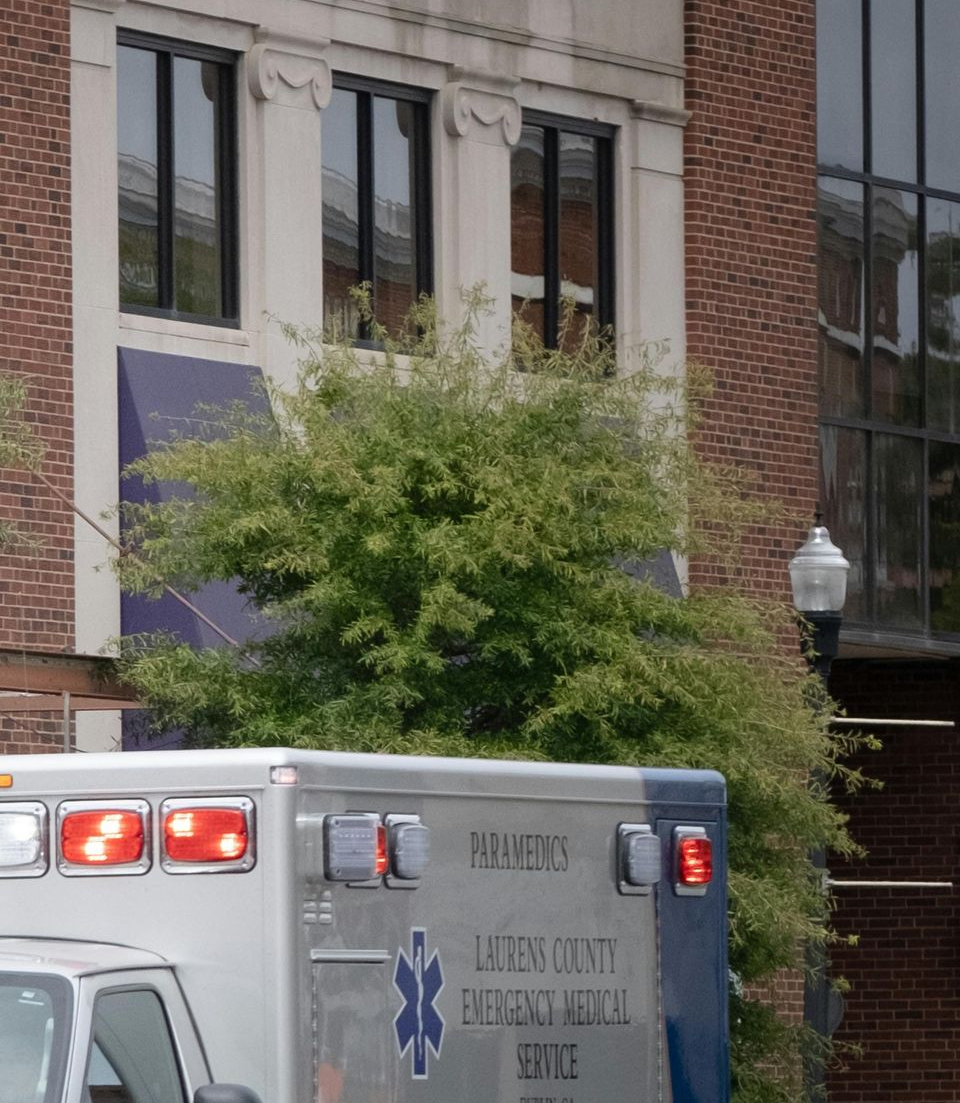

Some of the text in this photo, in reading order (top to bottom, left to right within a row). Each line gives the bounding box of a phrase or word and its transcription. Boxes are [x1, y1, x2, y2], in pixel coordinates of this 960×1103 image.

[470, 832, 569, 872] PARAMEDICS
[475, 935, 617, 974] LAURENS COUNTY
[462, 988, 631, 1026] EMERGENCY MEDICAL
[517, 1043, 578, 1080] SERVICE
